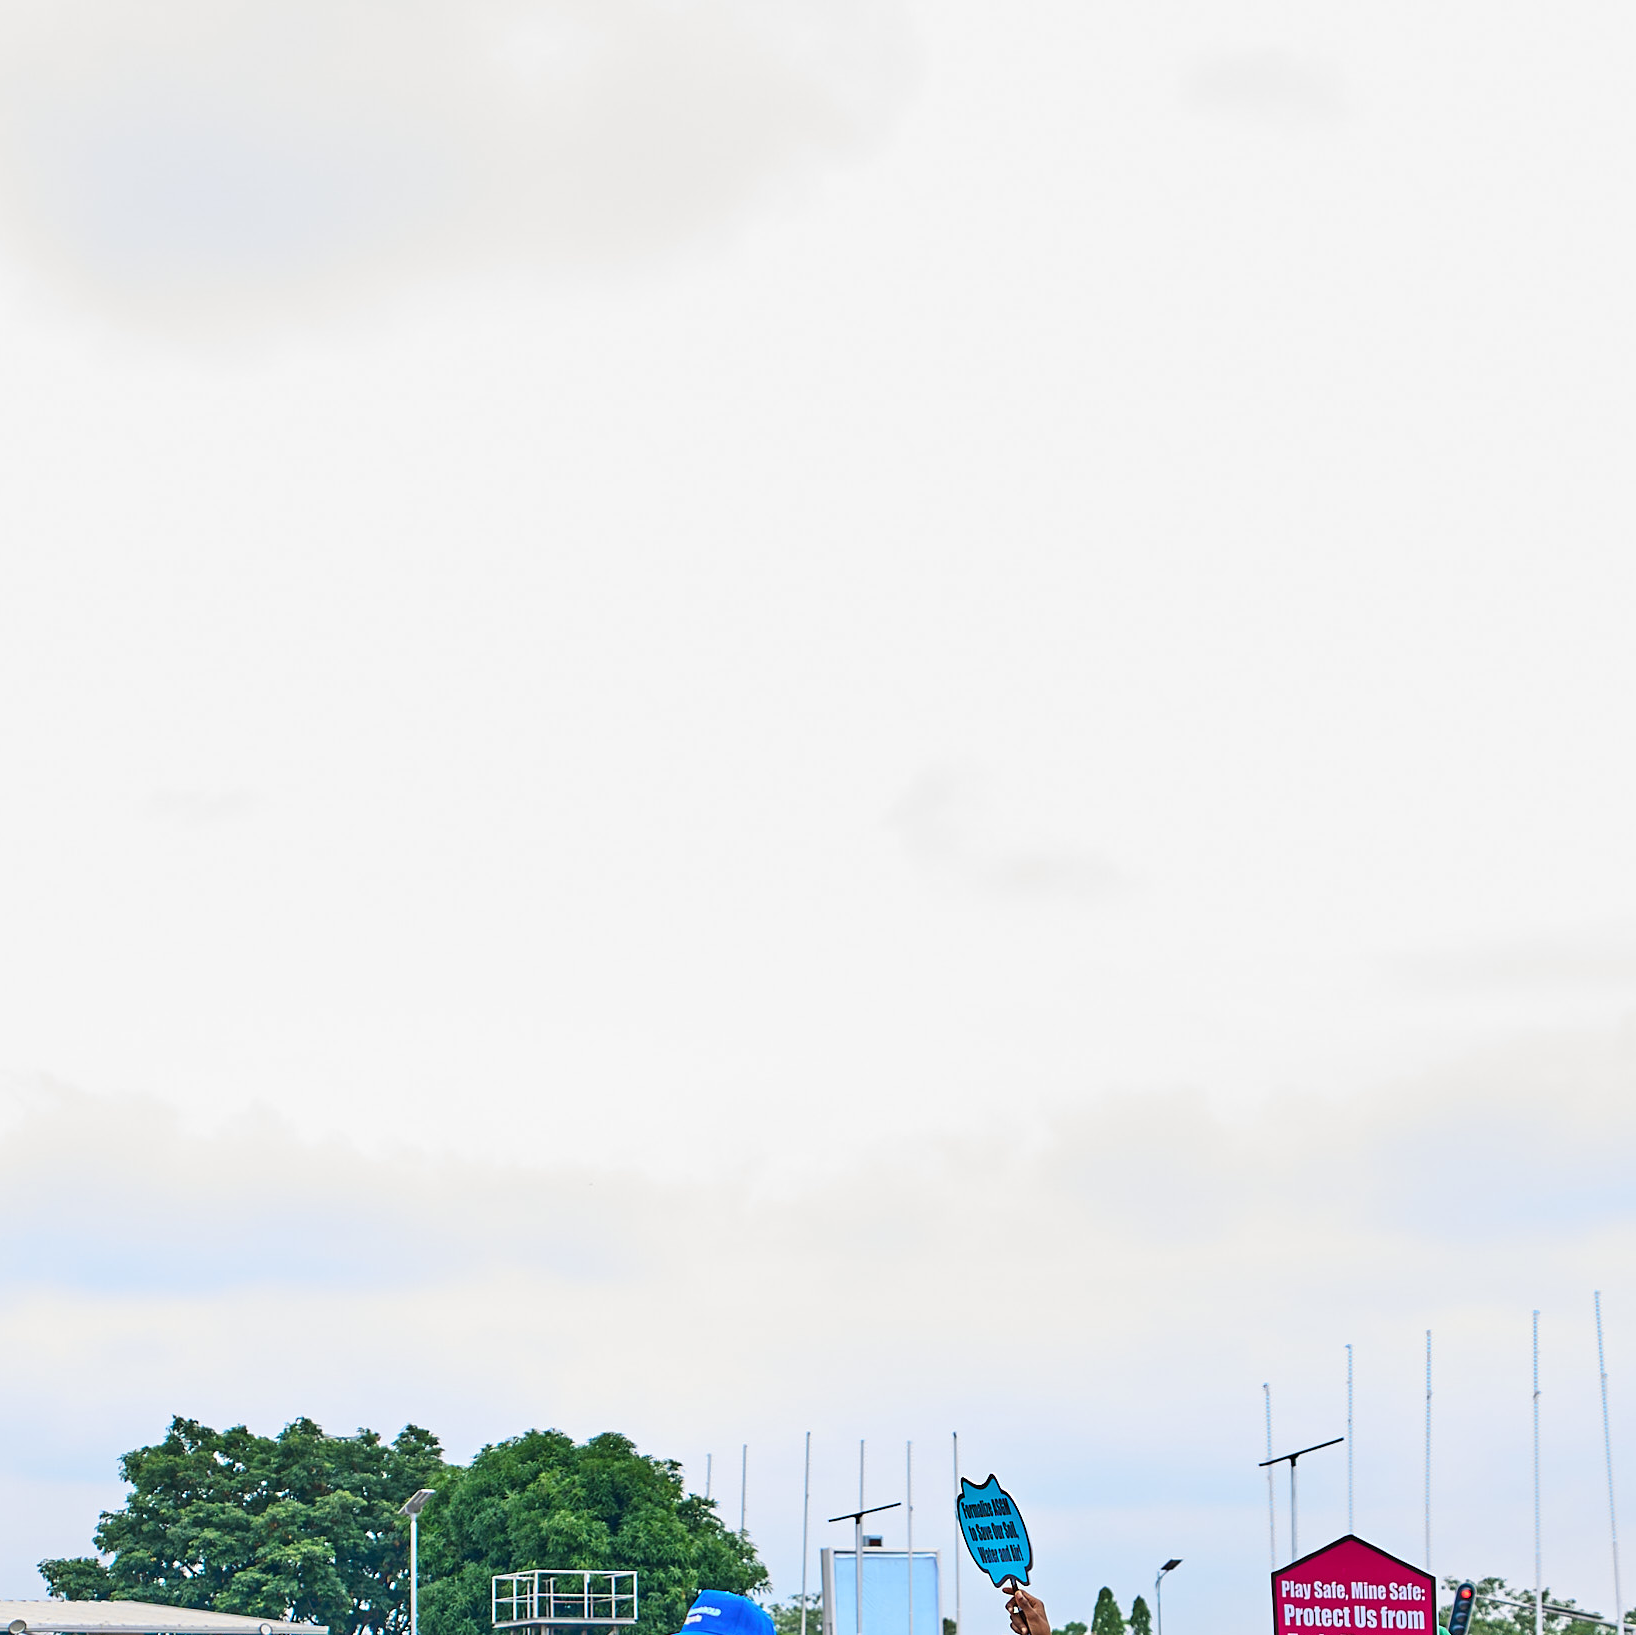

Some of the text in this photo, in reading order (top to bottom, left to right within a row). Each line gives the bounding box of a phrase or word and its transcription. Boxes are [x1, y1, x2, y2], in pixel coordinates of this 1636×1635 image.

[1281, 1580, 1425, 1600] Play Safe, Mine Safe:
[1284, 1604, 1425, 1629] Protect Us from
